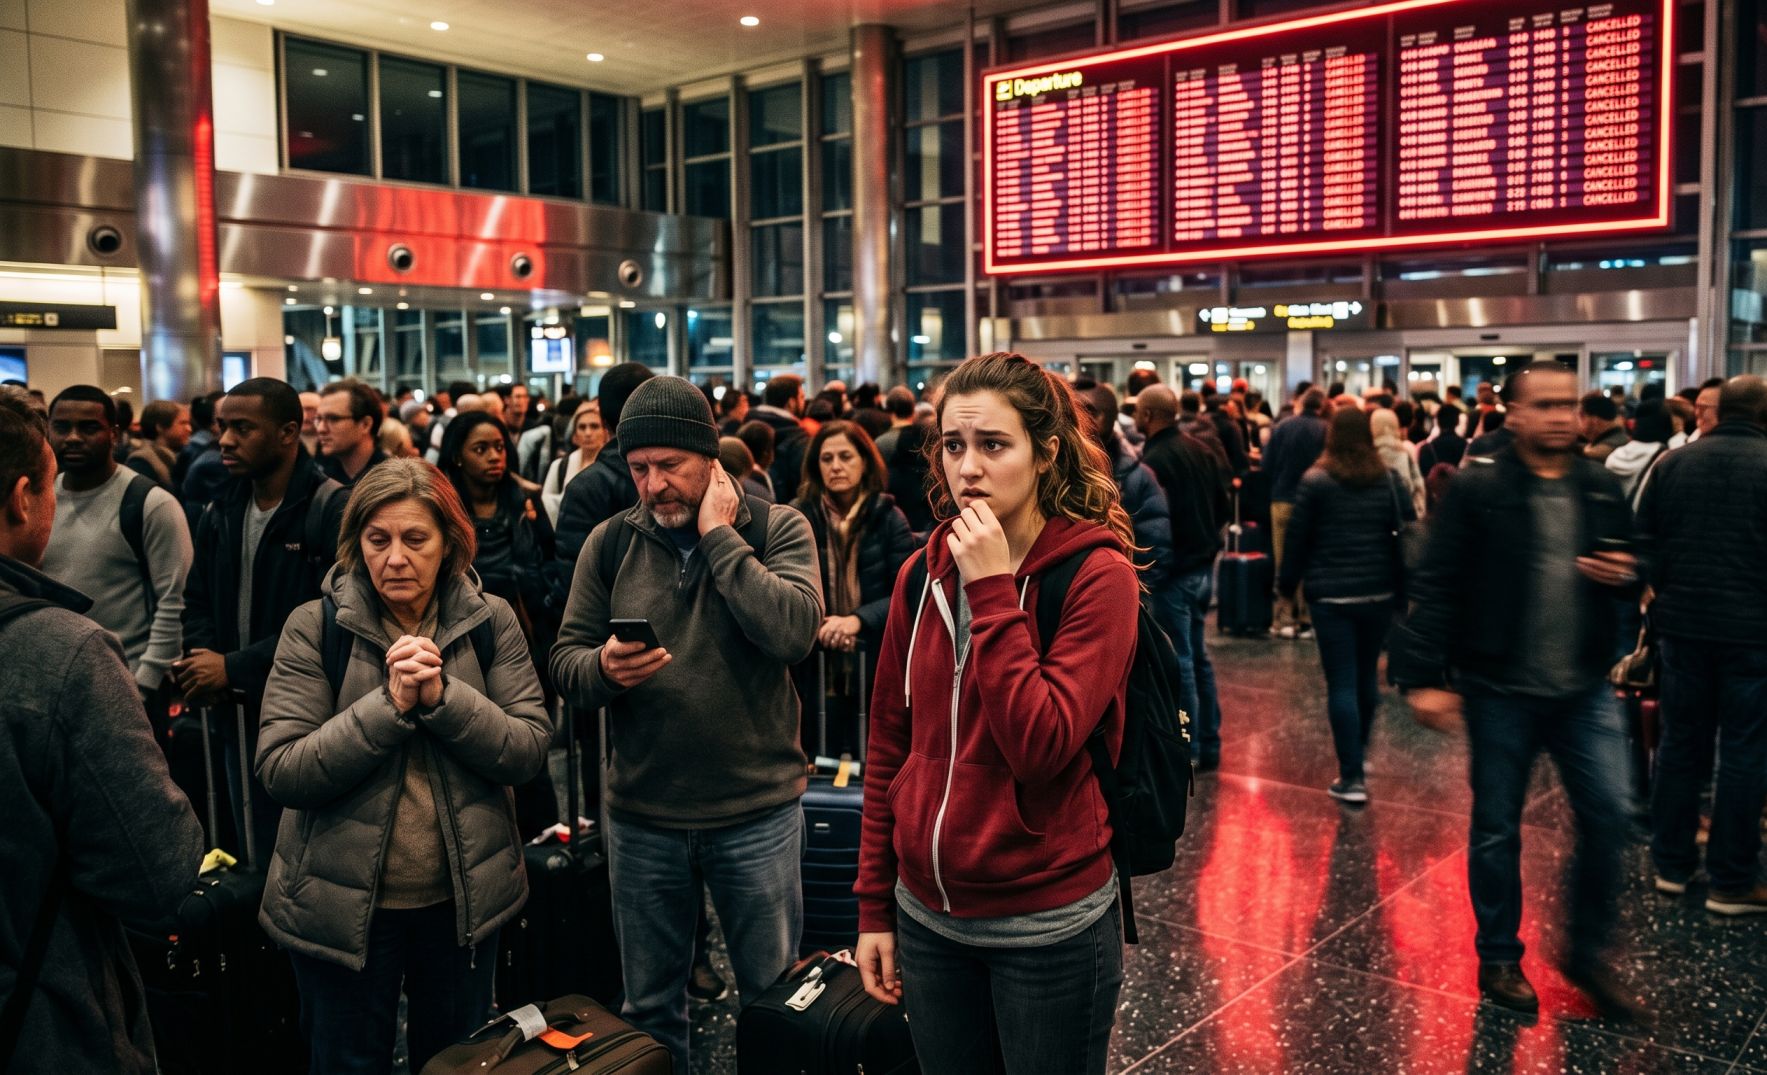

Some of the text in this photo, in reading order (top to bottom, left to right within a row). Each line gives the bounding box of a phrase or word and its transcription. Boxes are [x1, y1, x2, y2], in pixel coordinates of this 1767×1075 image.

[1586, 14, 1641, 33] CANCELLED
[1586, 28, 1640, 46] CANCELLED
[1586, 41, 1640, 60] CANCELLED
[1585, 55, 1640, 73] CANCELLED
[1014, 71, 1082, 97] Departure
[1585, 69, 1640, 86] CANCELLED
[1585, 82, 1639, 99] CANCELLED
[1585, 96, 1639, 113] CANCELLED
[1585, 109, 1639, 126] CANCELLED
[1584, 123, 1639, 139] CANCELLED
[1584, 137, 1638, 153] CANCELLED
[1584, 150, 1638, 166] CANCELLED
[1584, 164, 1638, 179] CANCELLED
[1583, 177, 1638, 192] CANCELLED
[1583, 191, 1637, 206] CANCELLED
